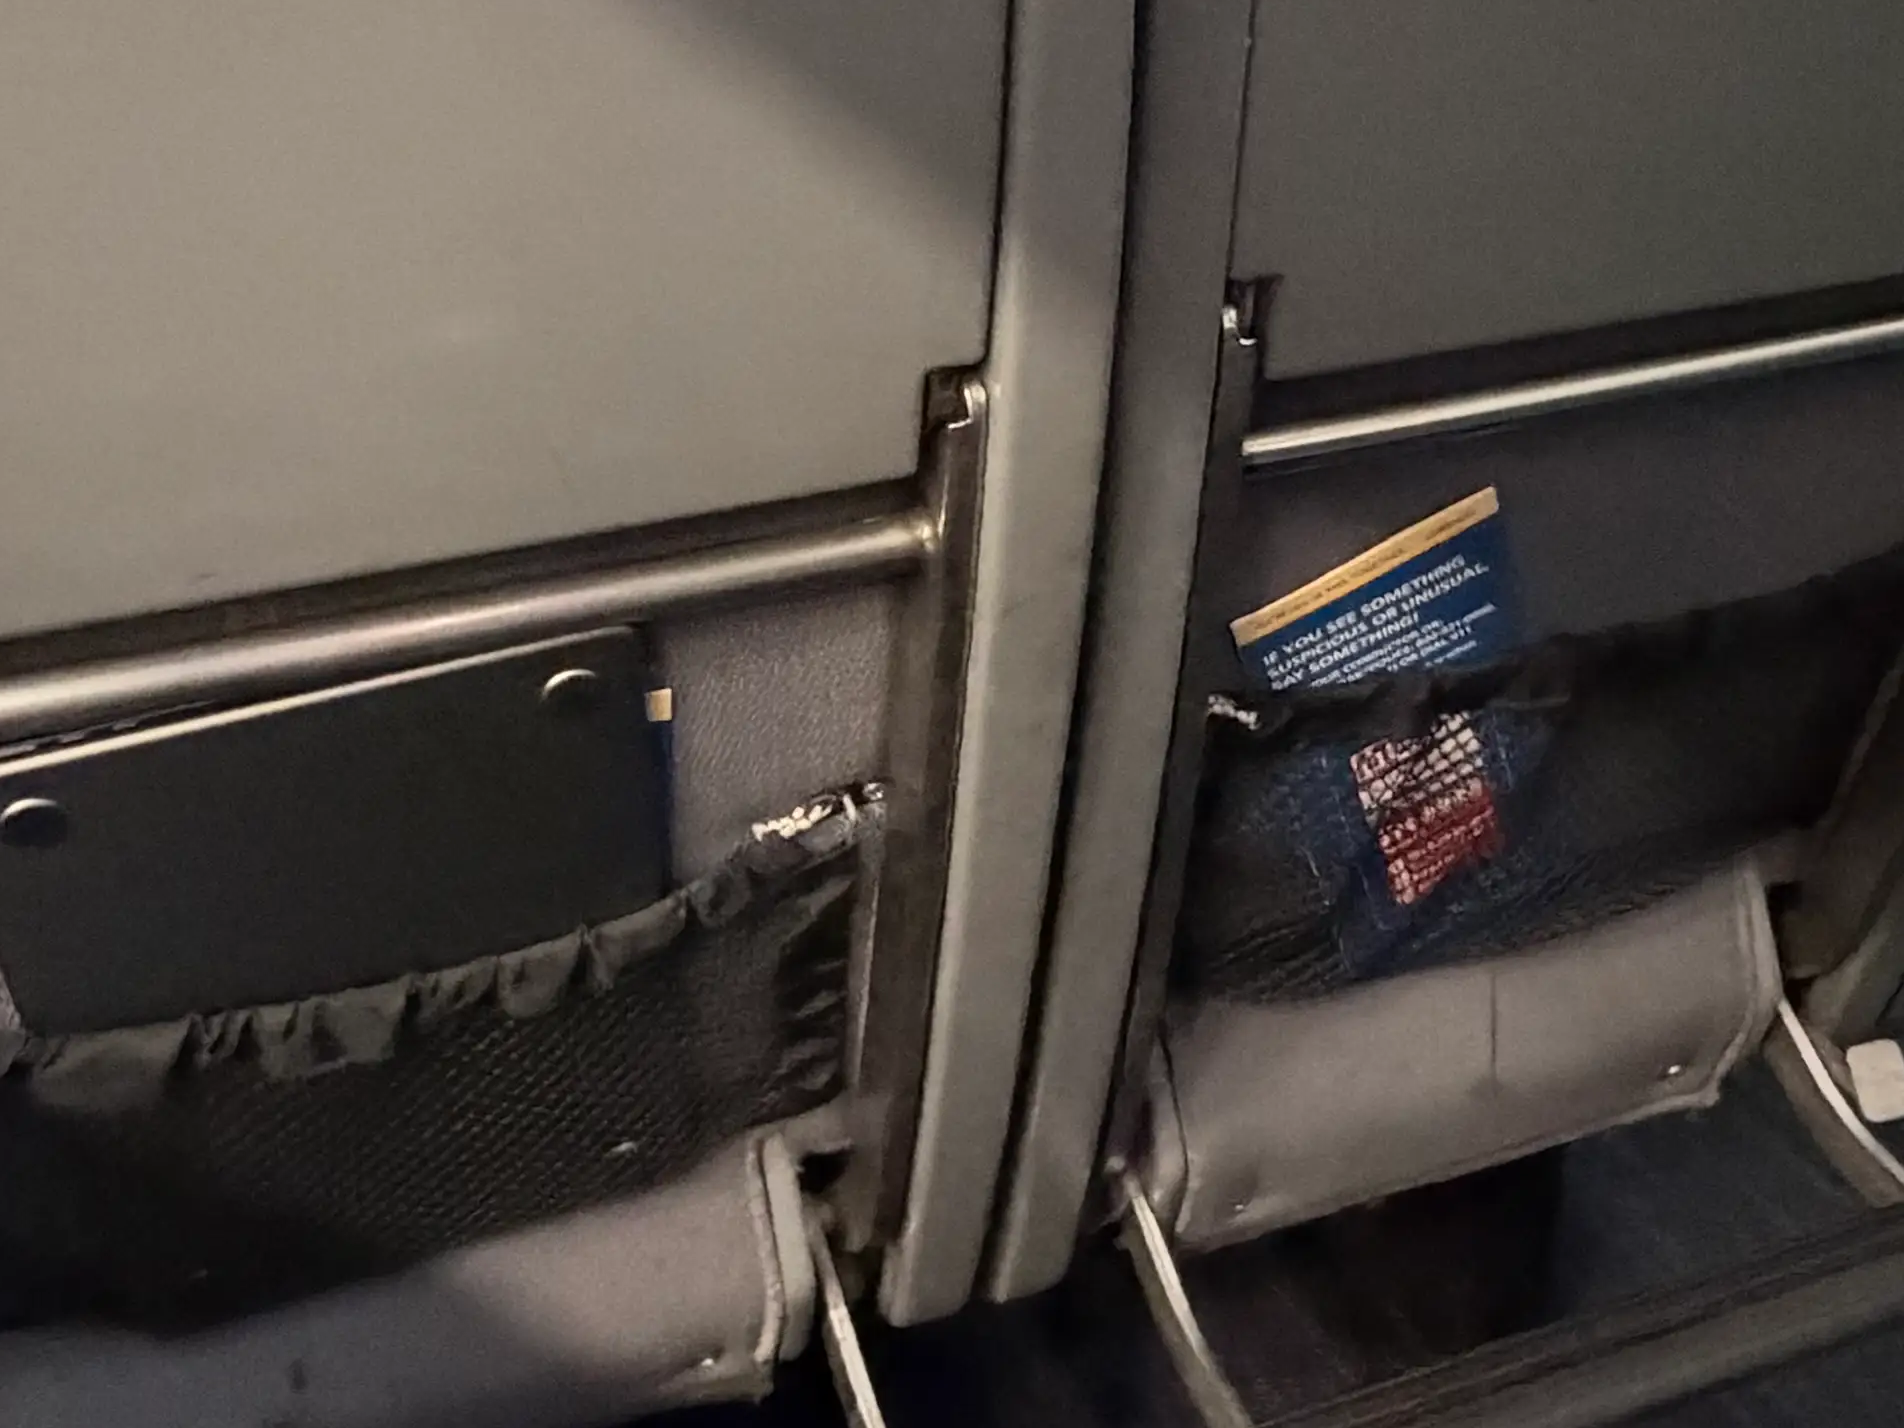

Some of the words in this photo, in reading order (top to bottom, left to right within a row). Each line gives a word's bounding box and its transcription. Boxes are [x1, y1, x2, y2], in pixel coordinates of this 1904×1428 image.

[1262, 649, 1277, 666] IF
[1281, 626, 1323, 653] YOU
[1324, 609, 1357, 634] SEE
[1359, 553, 1464, 617] SOMETHING
[1266, 621, 1369, 679] SUSPICIOUS
[1370, 605, 1398, 626] OR
[1270, 667, 1303, 691] SAY
[1308, 610, 1418, 673] SOMETHING!
